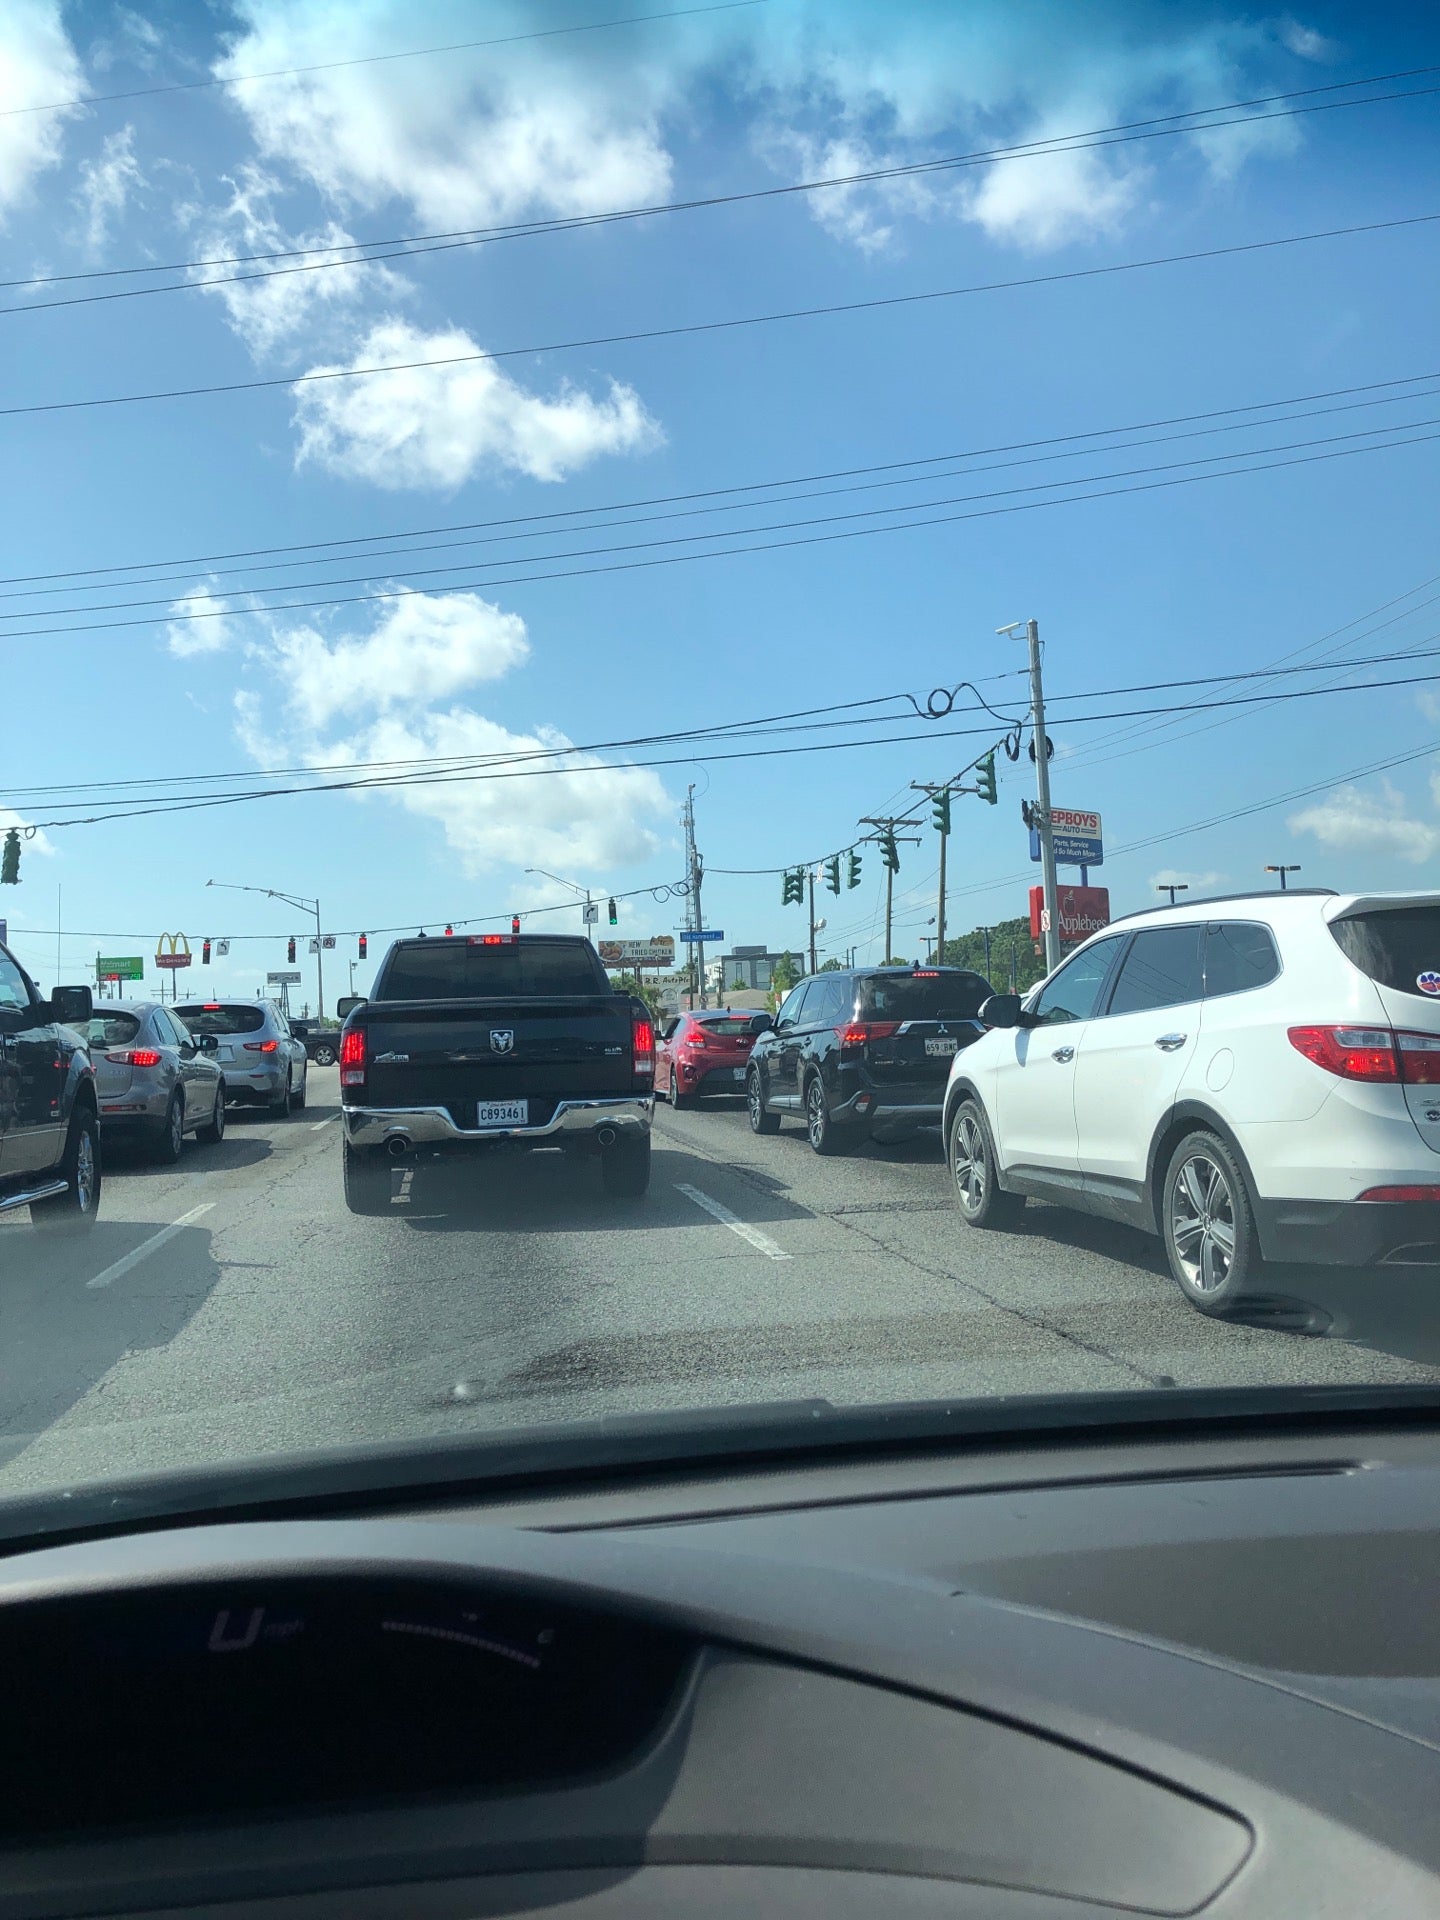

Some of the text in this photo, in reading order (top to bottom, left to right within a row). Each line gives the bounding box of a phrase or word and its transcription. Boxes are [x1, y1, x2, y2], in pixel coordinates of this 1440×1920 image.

[1049, 810, 1097, 828] EPBOYS
[1062, 826, 1081, 834] AUTO
[1070, 840, 1089, 849] Service
[1066, 848, 1082, 857] Much
[1082, 850, 1096, 858] More
[1058, 909, 1107, 935] Applebee's
[926, 1043, 940, 1052] 659
[480, 1107, 524, 1120] C893461
